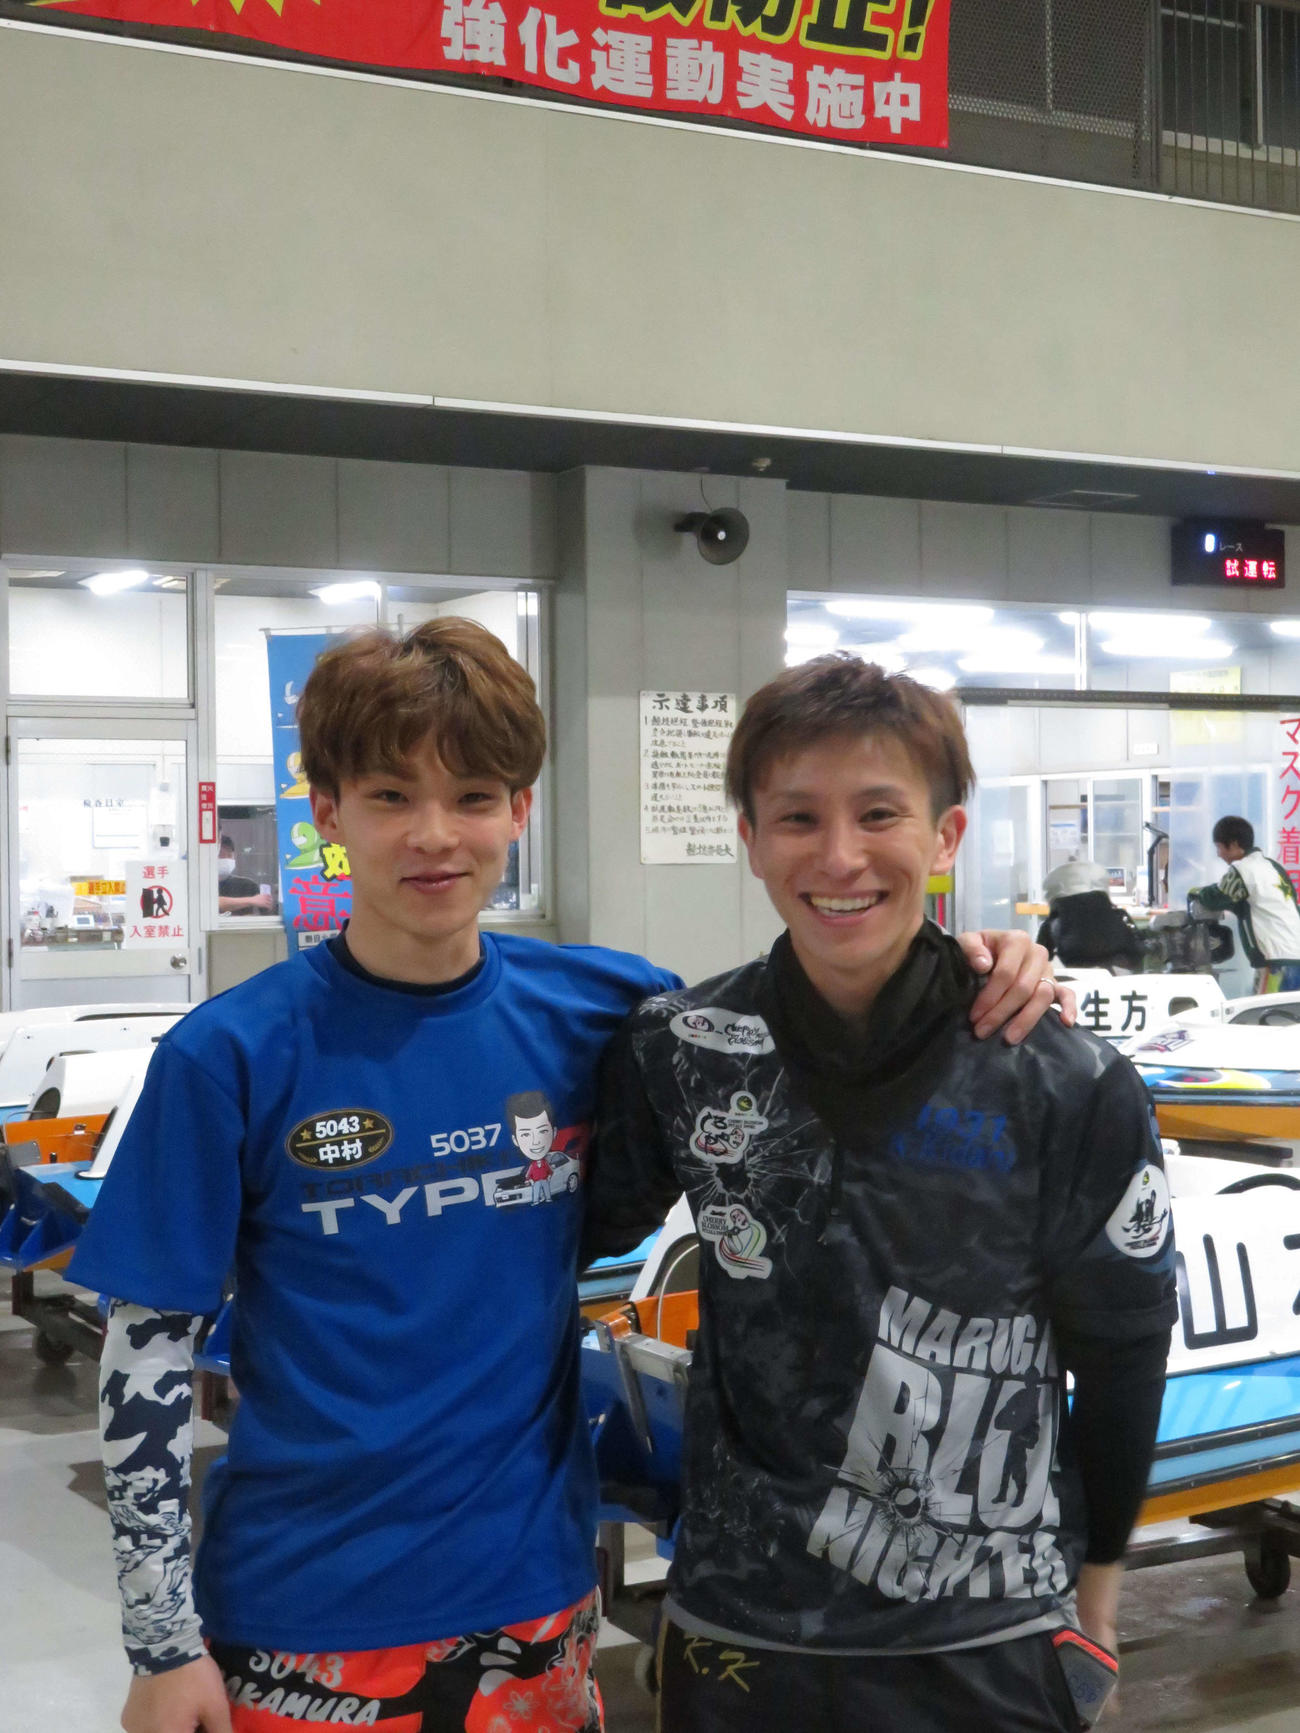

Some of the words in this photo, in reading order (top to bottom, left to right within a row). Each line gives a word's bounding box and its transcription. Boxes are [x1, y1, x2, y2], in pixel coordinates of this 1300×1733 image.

[440, 0, 922, 134] 強化運動実施中
[1220, 543, 1243, 552] レース
[1225, 559, 1276, 578] 試運転
[143, 866, 169, 879] 選手
[130, 925, 184, 938] 入室禁止
[1081, 990, 1148, 1032] 生方
[315, 1115, 360, 1139] 5043
[430, 1123, 501, 1157] 5037
[318, 1138, 363, 1164] 中村
[1175, 1233, 1300, 1350] 山
[223, 1674, 381, 1727] AKAMURA
